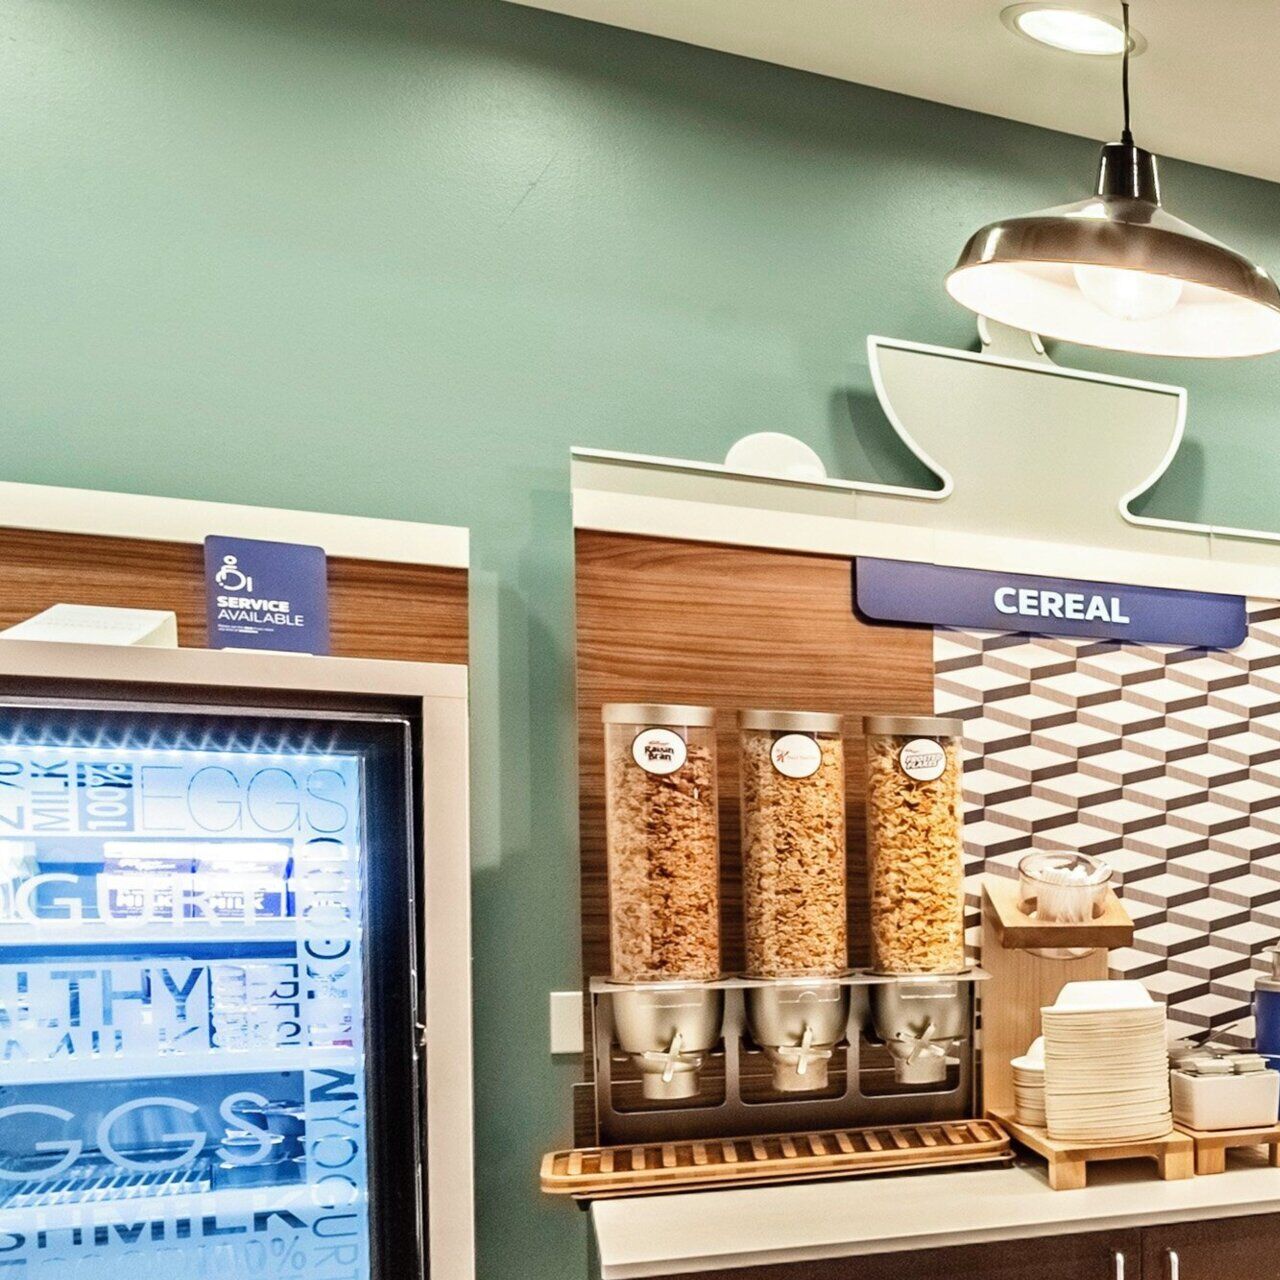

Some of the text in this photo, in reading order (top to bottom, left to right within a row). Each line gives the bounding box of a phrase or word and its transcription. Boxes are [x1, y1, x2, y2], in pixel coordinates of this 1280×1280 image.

[216, 595, 291, 613] SERVICE
[217, 608, 305, 627] AVAILABLE
[993, 586, 1131, 625] CEREAL
[30, 760, 69, 832] MILK
[86, 763, 128, 832] 100%
[141, 765, 349, 834] EGGS
[0, 967, 204, 1029] LTHY
